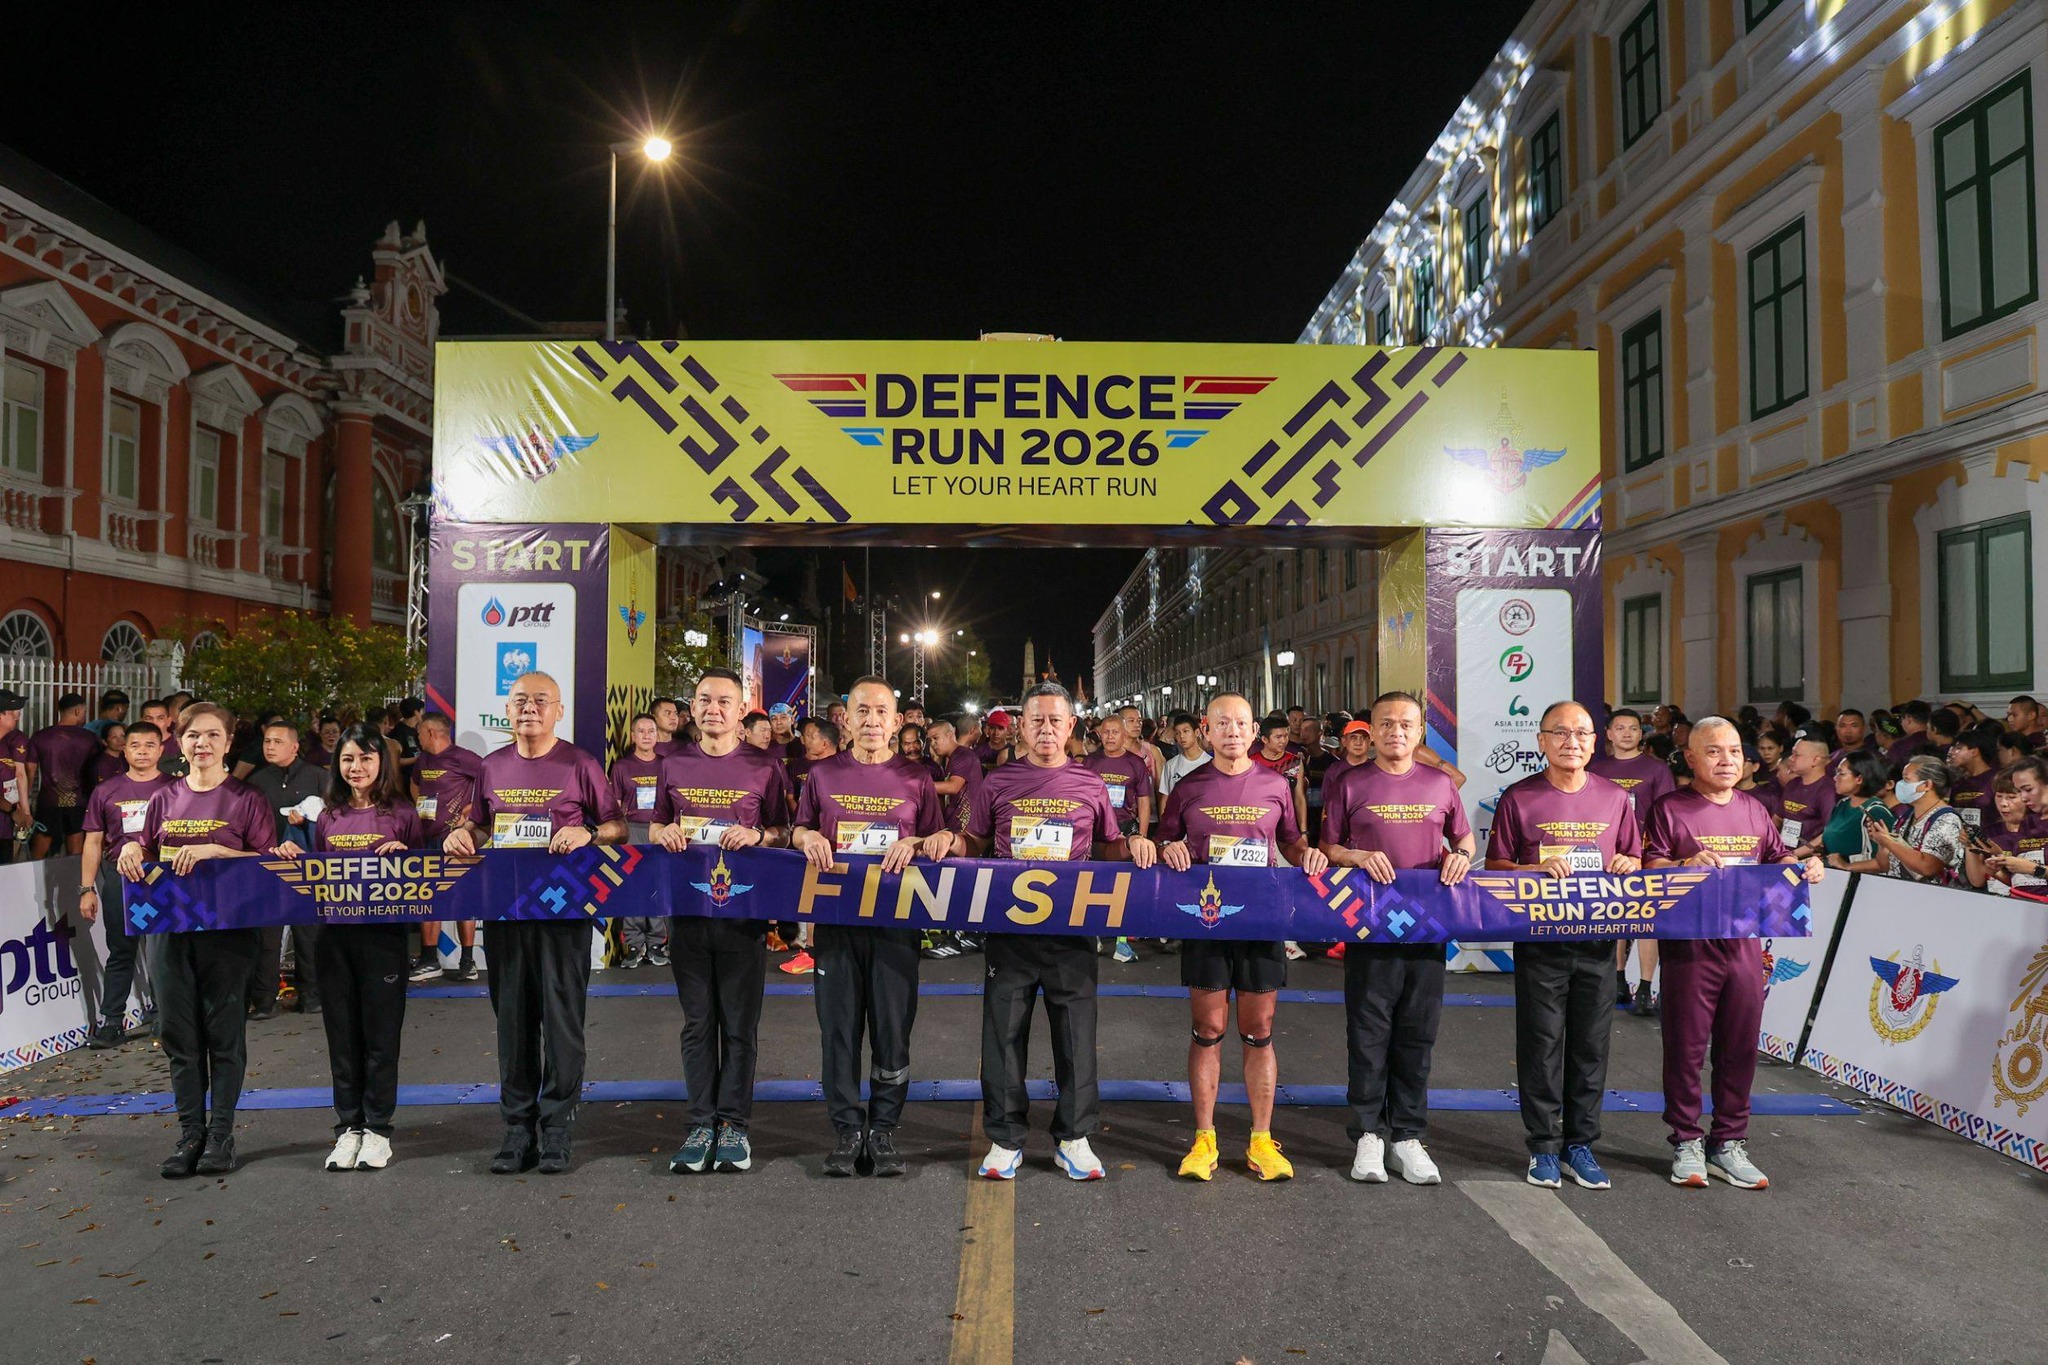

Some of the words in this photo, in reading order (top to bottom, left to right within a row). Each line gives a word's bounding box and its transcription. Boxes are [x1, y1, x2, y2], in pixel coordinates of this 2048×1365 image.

[875, 373, 1176, 420] DEFENCE
[892, 428, 1005, 465] RUN
[1020, 428, 1160, 467] 2026
[893, 475, 938, 495] LET
[944, 475, 1011, 496] YOUR
[1018, 476, 1100, 496] HEART
[1107, 477, 1157, 497] RUN
[451, 539, 590, 571] START
[1446, 546, 1582, 578] START
[507, 601, 556, 628] ptt
[523, 620, 551, 629] Group
[1506, 653, 1527, 675] PT
[1515, 751, 1546, 763] FPV
[505, 789, 548, 797] DEFENCE
[690, 788, 735, 798] DEFENCE
[711, 797, 732, 805] 2026
[844, 795, 891, 805] DEFENCE
[1022, 798, 1069, 807] DEFENCE
[865, 804, 888, 812] 2026
[1044, 806, 1067, 814] 2026
[1213, 806, 1259, 814] DEFENCE
[1380, 804, 1426, 813] DEFENCE
[1402, 811, 1424, 819] 2026
[168, 819, 214, 827] DEFENCE
[1551, 822, 1599, 830] DEFENCE
[497, 824, 509, 833] VIP
[515, 824, 521, 837] V
[524, 825, 548, 838] 1001
[684, 828, 695, 836] VIP
[701, 828, 708, 840] V
[1015, 827, 1028, 837] VIP
[1035, 828, 1042, 840] V
[1054, 831, 1060, 842] 1
[842, 833, 855, 842] VIP
[862, 833, 869, 845] V
[880, 834, 887, 846] 2
[1709, 835, 1753, 844] DEFENCE
[1213, 846, 1226, 855] VIP
[1232, 848, 1240, 860] V
[1241, 849, 1267, 863] 2322
[304, 855, 441, 882] DEFENCE
[1574, 856, 1600, 868] 3906
[314, 883, 363, 902] RUN
[369, 881, 434, 901] 2026
[1517, 874, 1665, 900] DEFENCE
[797, 863, 1132, 928] FINISH
[316, 906, 335, 917] LET
[336, 905, 366, 916] YOUR
[368, 904, 407, 915] HEART
[409, 904, 433, 914] RUN
[1529, 901, 1585, 921] RUN
[1591, 900, 1657, 920] 2026
[1530, 925, 1550, 935] LET
[1555, 924, 1587, 935] YOUR
[1589, 923, 1628, 934] HEART
[1630, 922, 1655, 933] RUN
[24, 978, 81, 1006] Group
